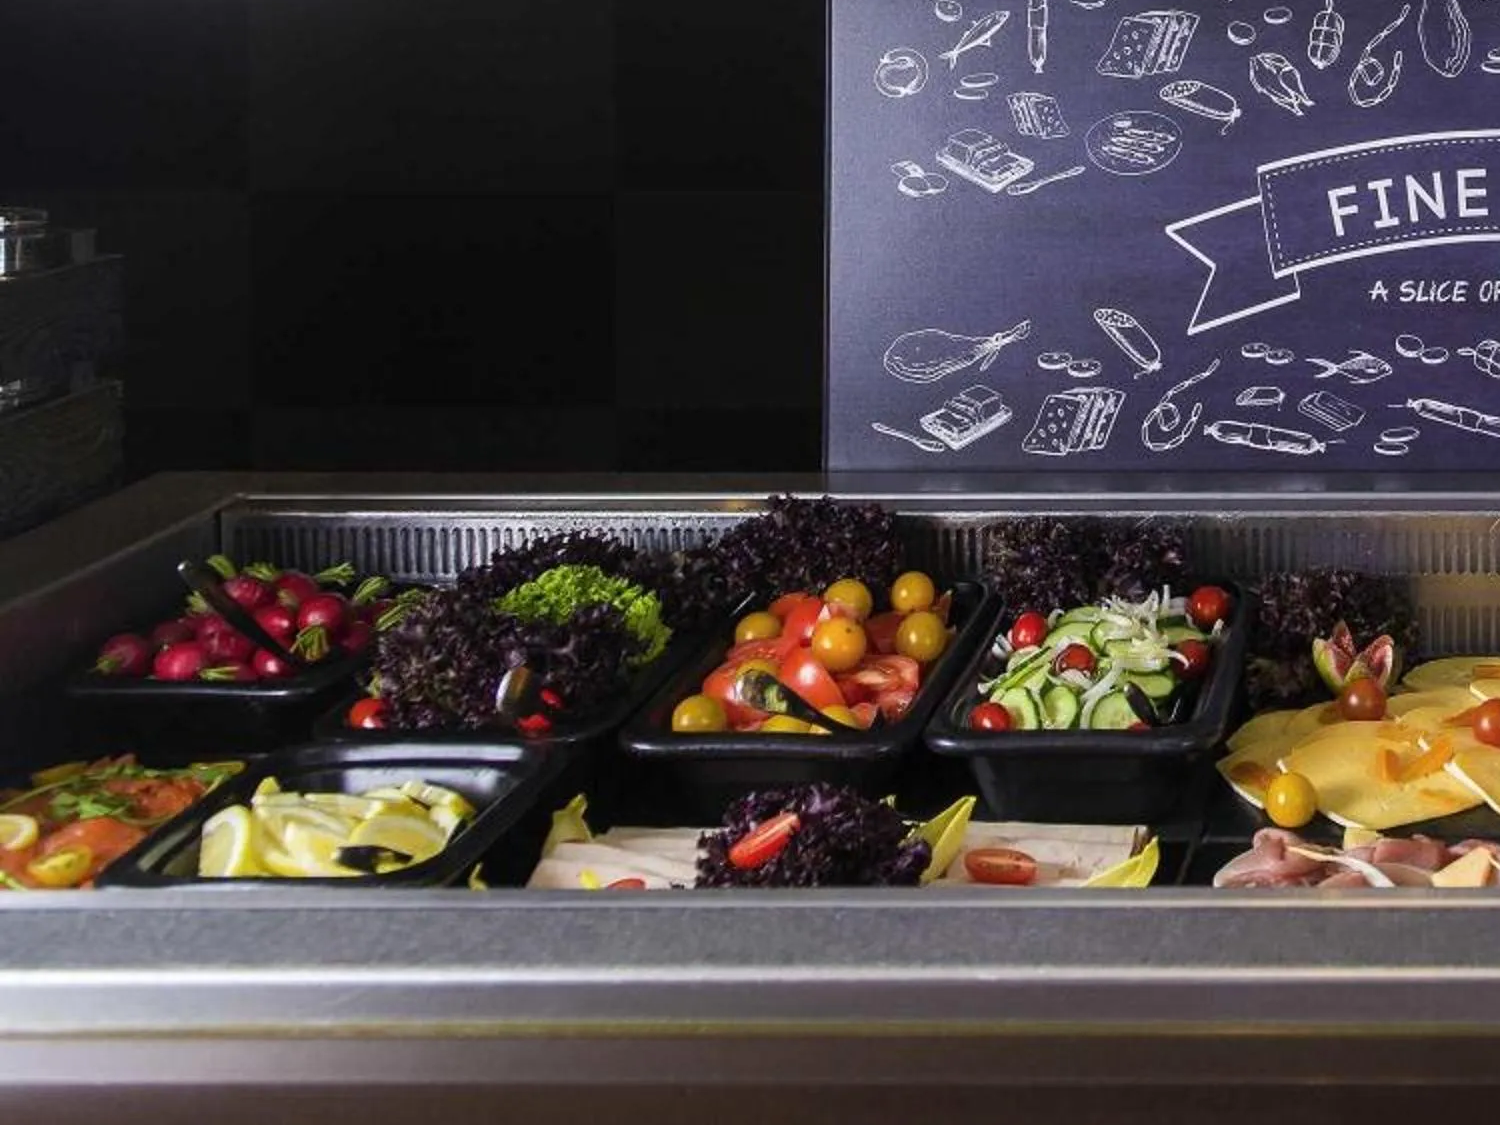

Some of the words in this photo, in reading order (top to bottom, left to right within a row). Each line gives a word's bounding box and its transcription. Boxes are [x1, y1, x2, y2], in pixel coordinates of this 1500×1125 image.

[1326, 168, 1490, 237] FINE
[1368, 280, 1389, 303] A
[1398, 280, 1469, 303] SLICE
